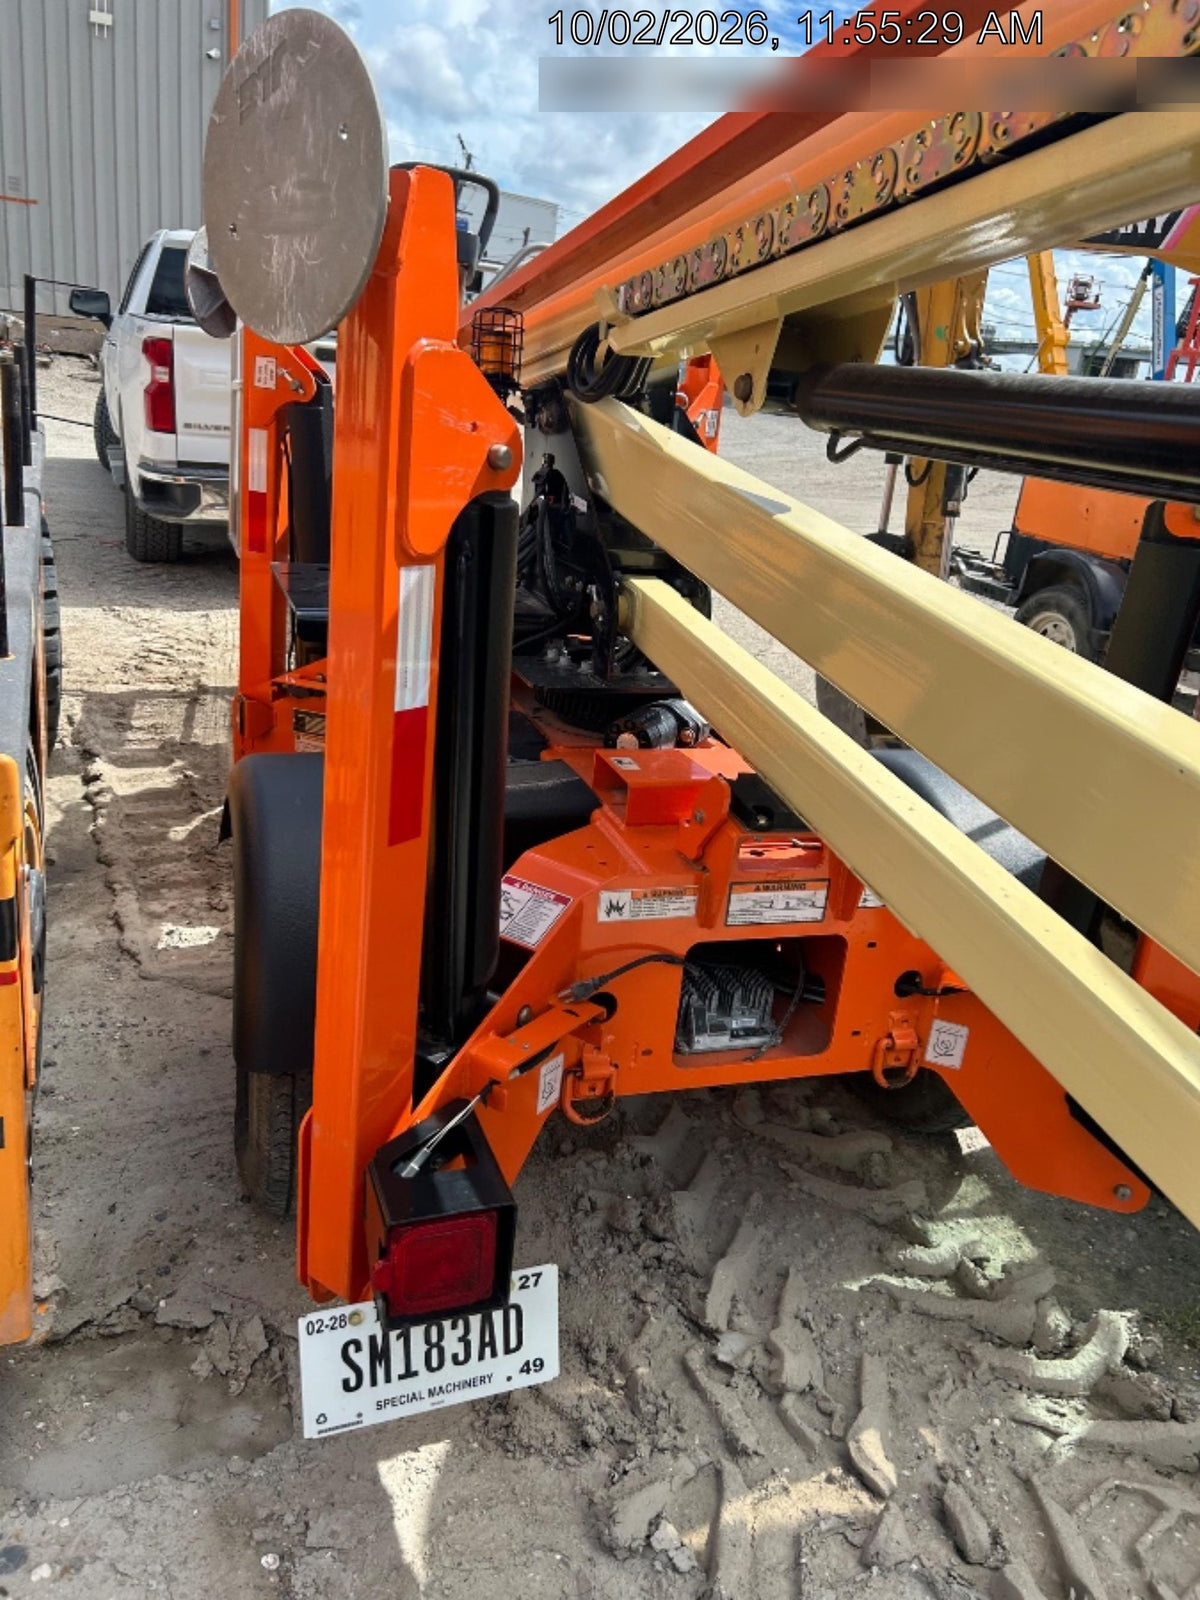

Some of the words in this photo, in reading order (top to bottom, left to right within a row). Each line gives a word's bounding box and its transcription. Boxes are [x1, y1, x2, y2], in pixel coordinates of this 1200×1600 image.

[183, 422, 231, 431] SILVER
[518, 1272, 543, 1290] 27
[306, 1313, 347, 1336] 02-28
[341, 1302, 524, 1393] SM183AD
[519, 1357, 545, 1376] 49
[375, 1391, 426, 1411] SPECIAL
[428, 1373, 494, 1399] MACHINERY
